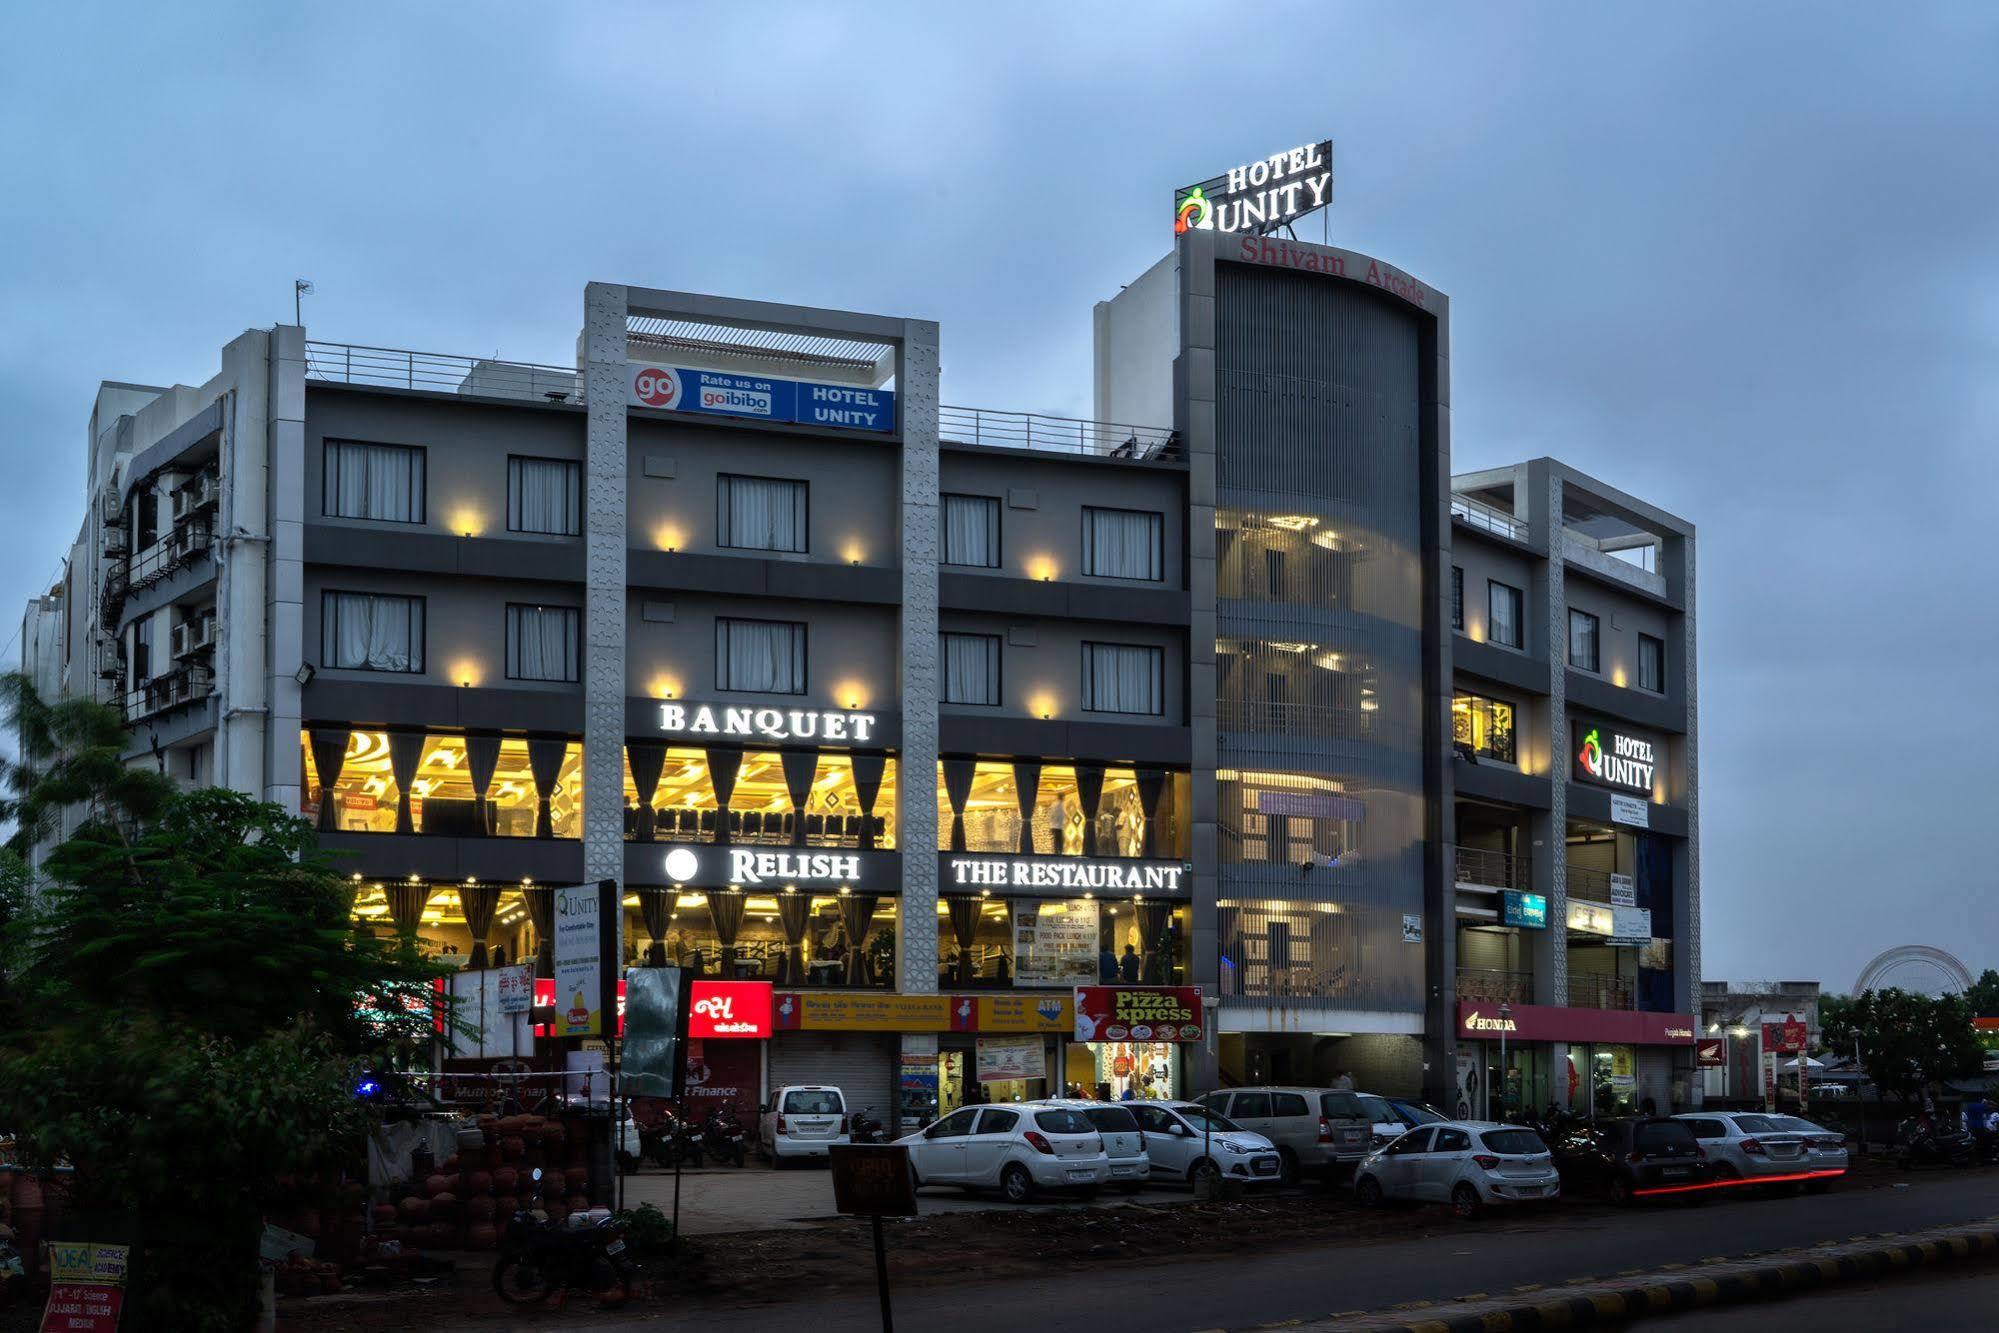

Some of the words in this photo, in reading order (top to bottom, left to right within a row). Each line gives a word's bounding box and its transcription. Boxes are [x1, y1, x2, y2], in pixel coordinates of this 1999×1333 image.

[1227, 143, 1322, 194] HOTEL
[1216, 172, 1331, 232] UNITY
[1241, 236, 1346, 277] Shivam
[1365, 260, 1425, 307] Arcade
[637, 374, 674, 399] go
[700, 374, 730, 387] Rate
[736, 380, 751, 389] us
[755, 382, 771, 391] on
[704, 391, 767, 408] goibibo
[813, 388, 878, 407] HOTEL
[815, 408, 877, 426] UNITY
[660, 704, 875, 740] BANQUET
[1614, 735, 1654, 763] HOTEL
[1604, 755, 1654, 790] UNITY
[729, 850, 861, 883] RELISH
[952, 860, 1007, 885] THE
[1012, 862, 1182, 889] RESTAURANT
[569, 896, 599, 916] UNITY
[1038, 1000, 1062, 1011] ATM
[1116, 992, 1178, 1007] Pizza
[1116, 1008, 1192, 1025] xpress
[692, 1086, 737, 1097] Finance
